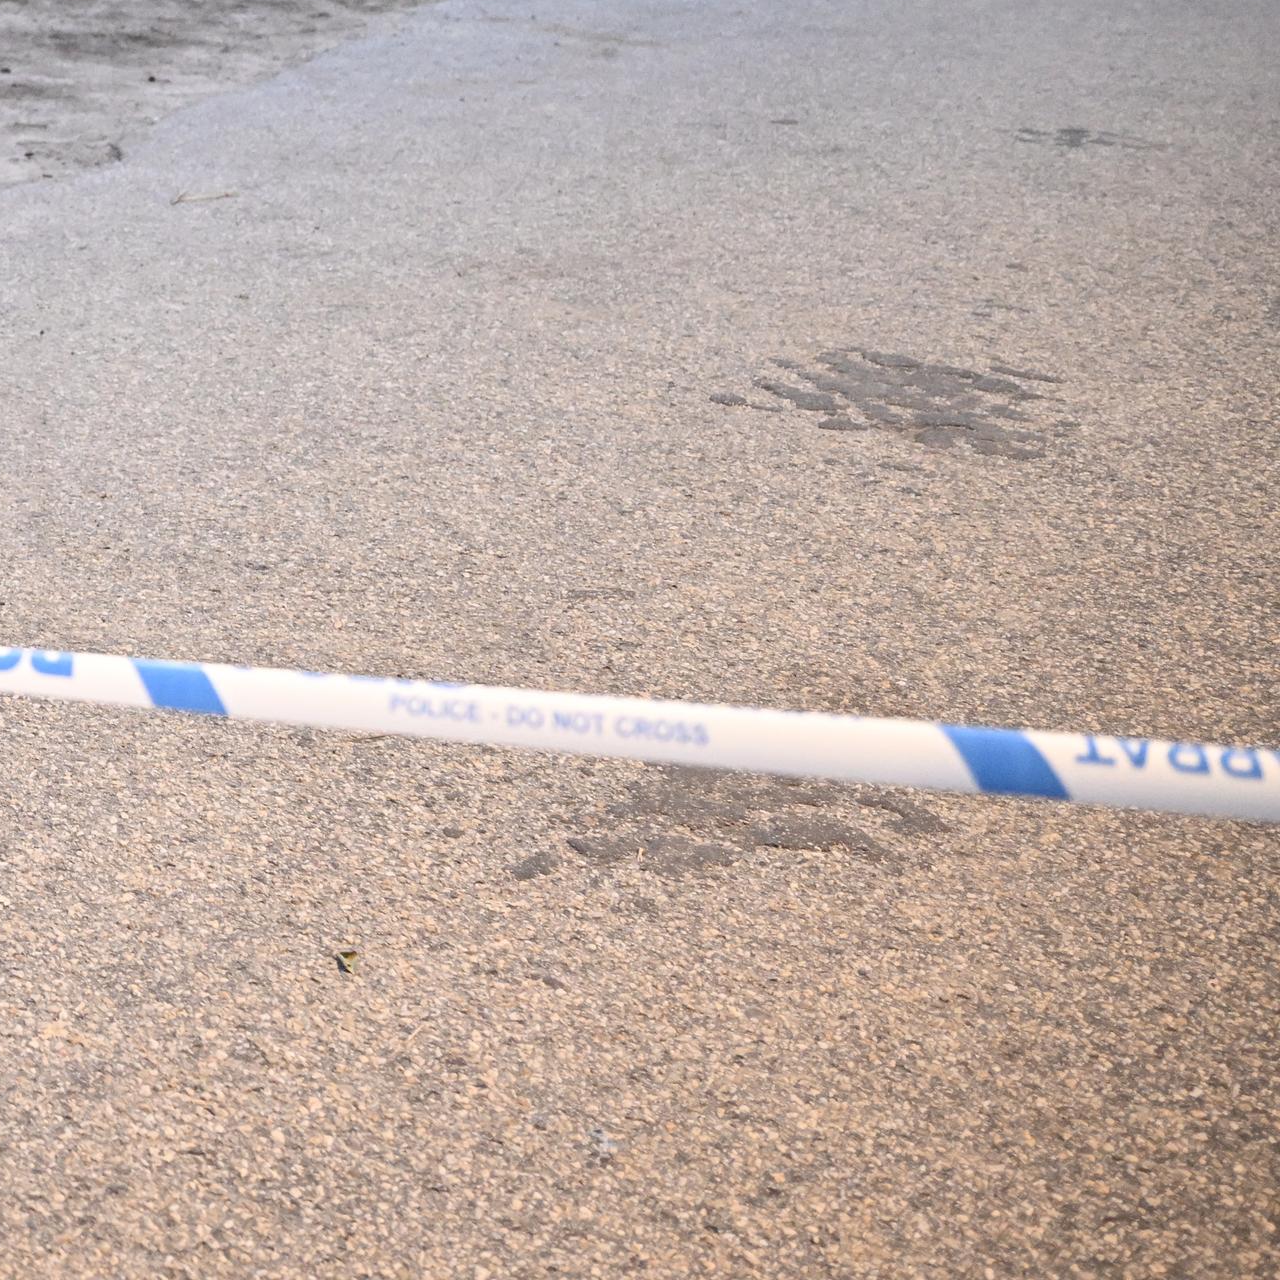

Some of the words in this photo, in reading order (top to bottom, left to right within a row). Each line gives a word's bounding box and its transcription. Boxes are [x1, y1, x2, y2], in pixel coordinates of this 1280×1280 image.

[388, 693, 481, 723] POLICE
[506, 704, 542, 728] DO
[553, 711, 604, 734] NOT
[614, 714, 710, 746] CROSS
[1075, 735, 1280, 780] RRAT
